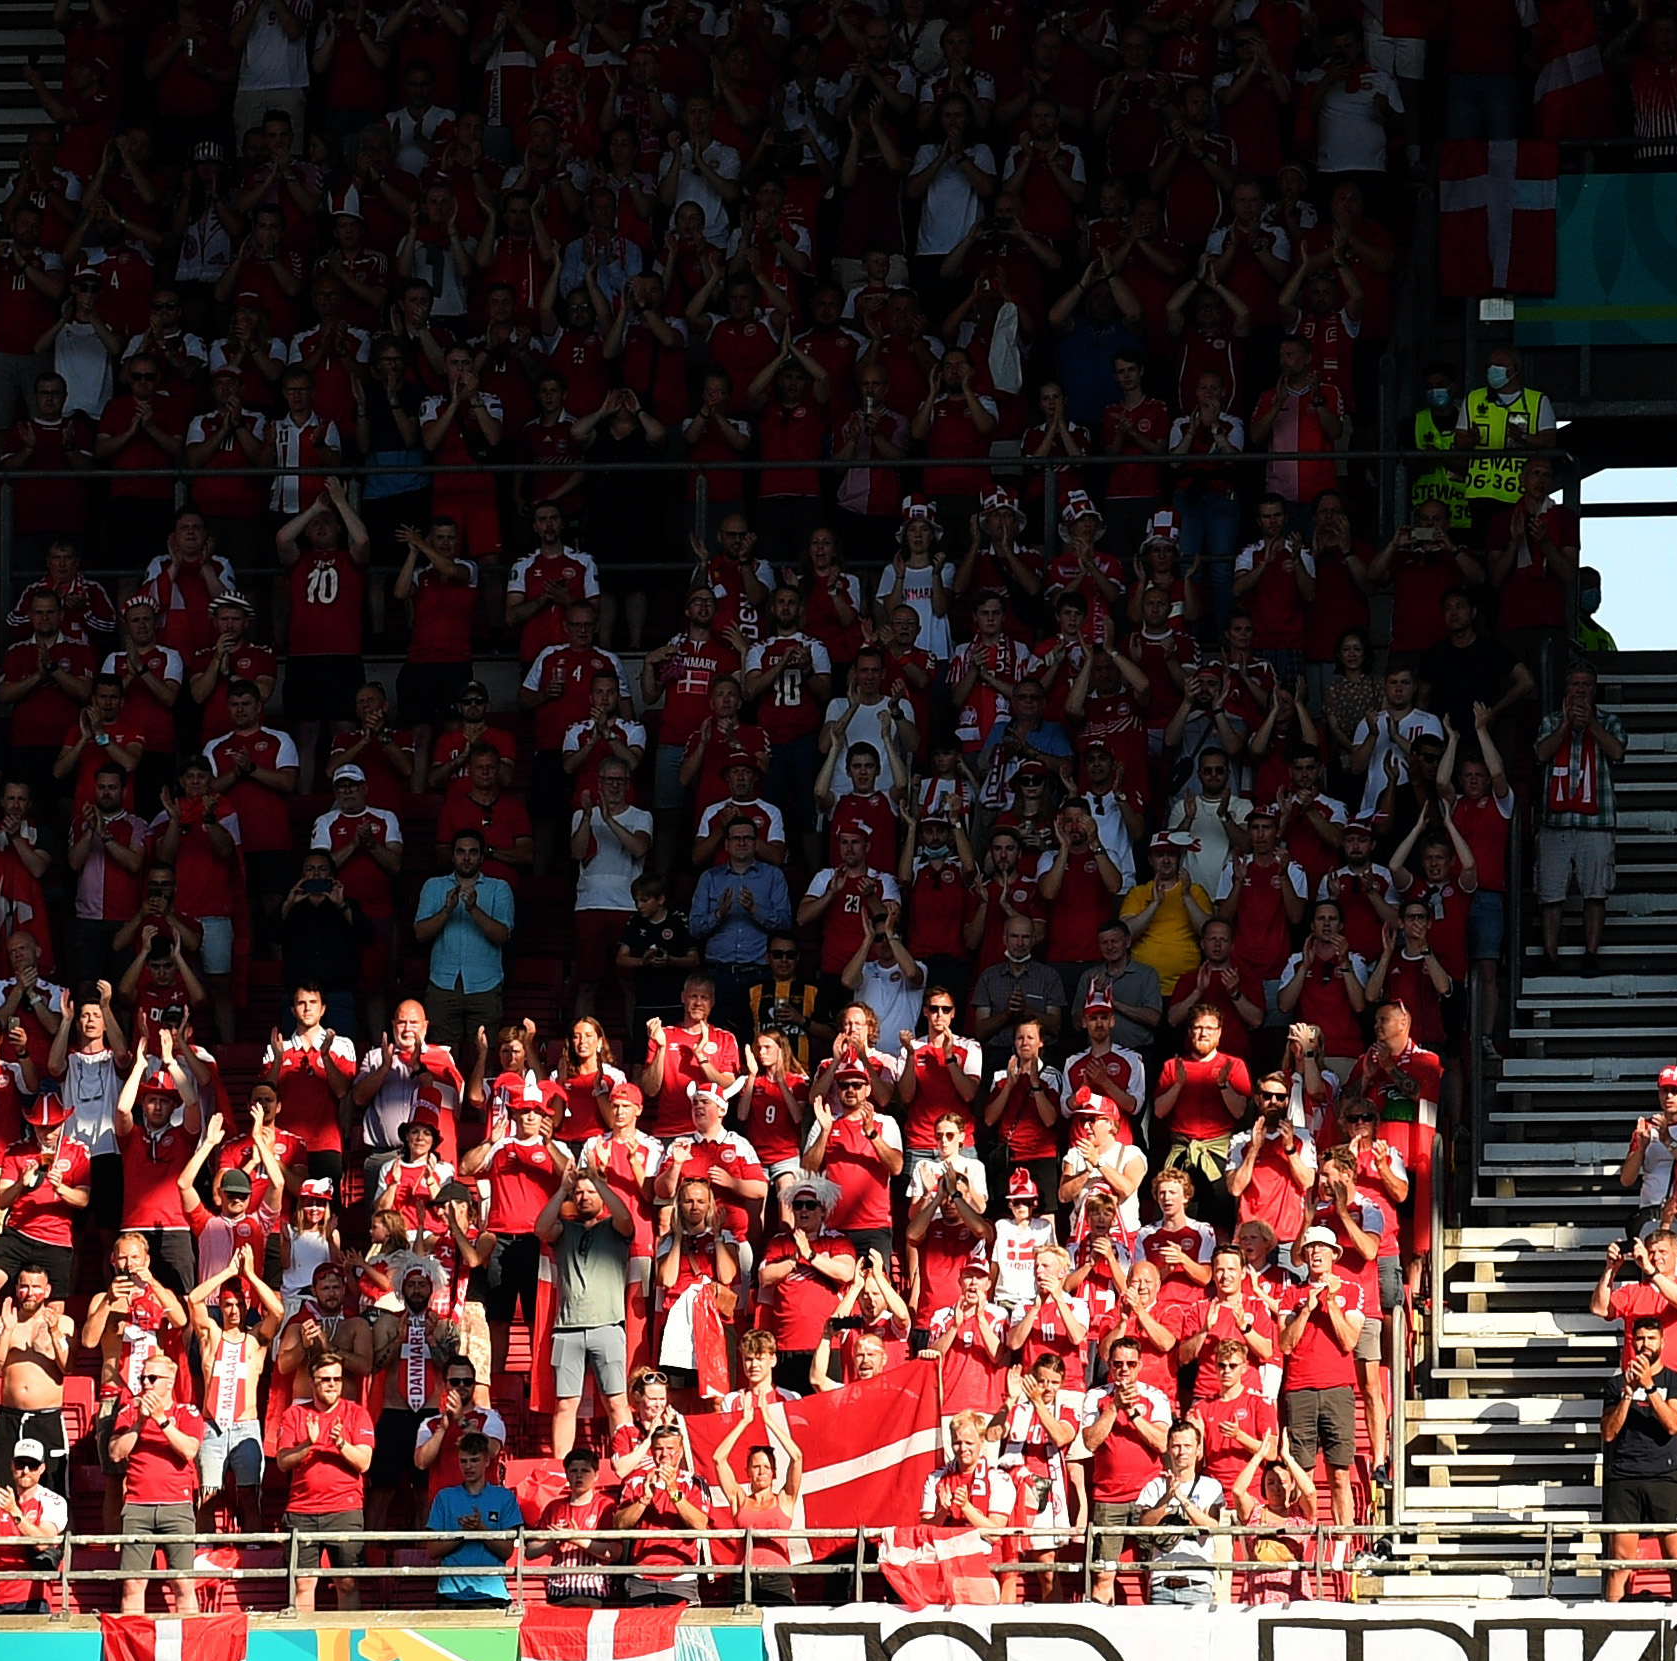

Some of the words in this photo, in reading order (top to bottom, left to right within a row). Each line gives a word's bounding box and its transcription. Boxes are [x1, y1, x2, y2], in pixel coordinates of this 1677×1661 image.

[11, 274, 26, 291] 10
[111, 270, 120, 289] 4
[306, 566, 339, 604] 10
[572, 665, 581, 682] 4
[844, 895, 861, 913] 23
[765, 1105, 776, 1123] 9
[1041, 1322, 1055, 1342] 10
